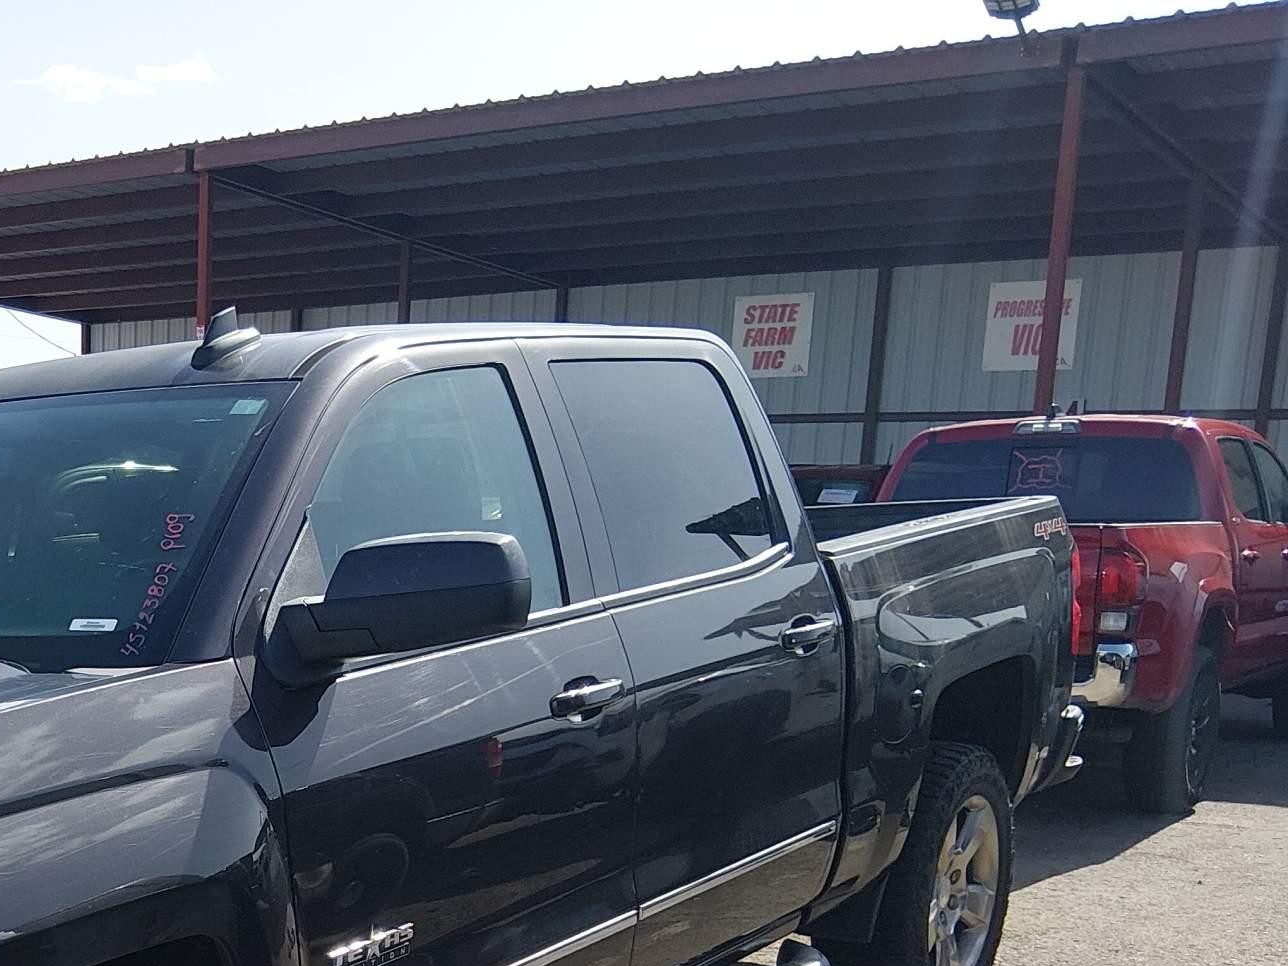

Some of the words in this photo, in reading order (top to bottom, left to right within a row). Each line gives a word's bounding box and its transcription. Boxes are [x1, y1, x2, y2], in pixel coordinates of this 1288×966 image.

[743, 303, 801, 325] STATE
[742, 326, 797, 348] FARM
[752, 350, 786, 371] VIC
[120, 561, 177, 656] 45123807
